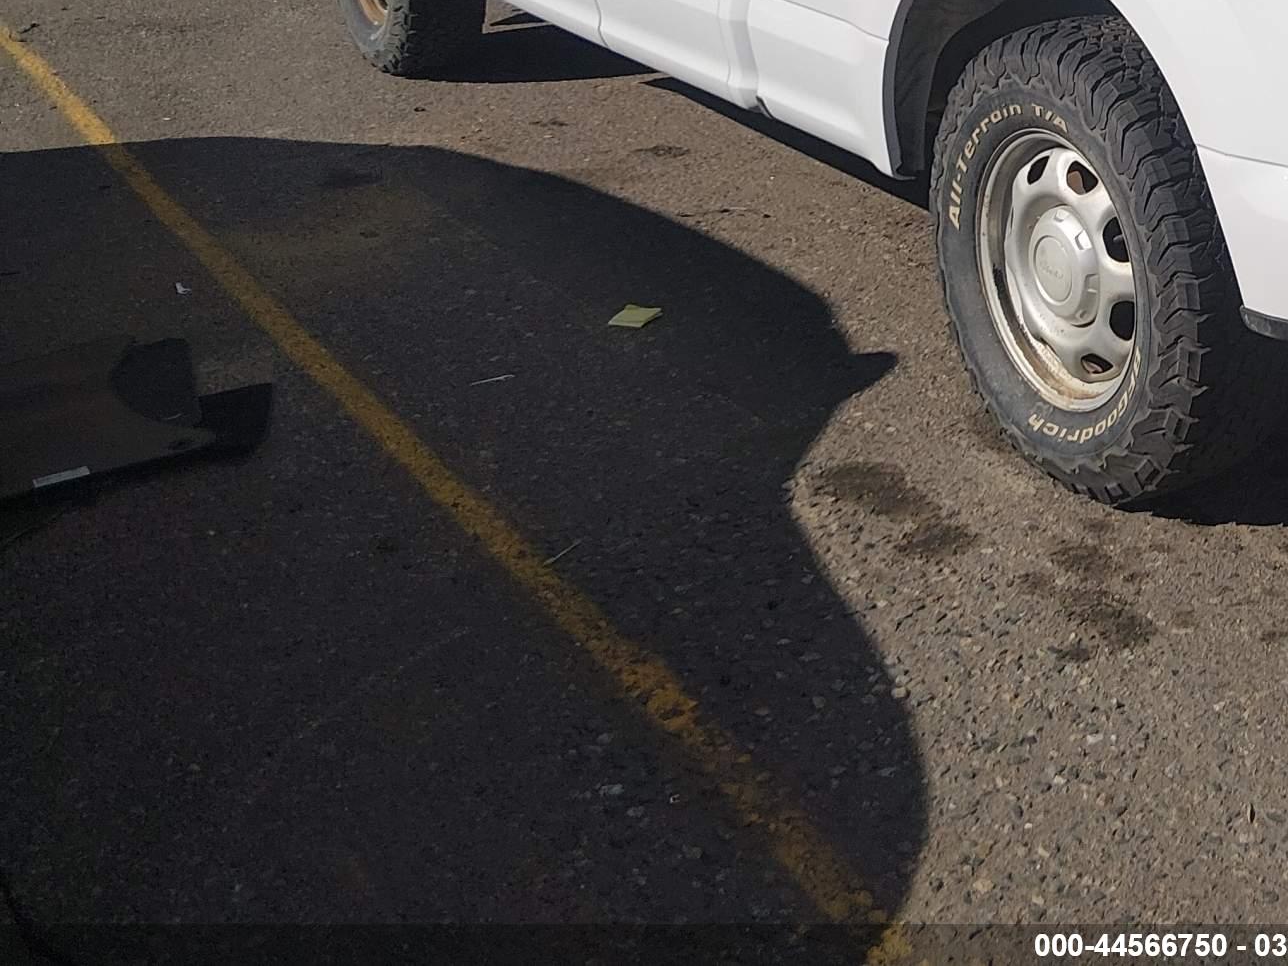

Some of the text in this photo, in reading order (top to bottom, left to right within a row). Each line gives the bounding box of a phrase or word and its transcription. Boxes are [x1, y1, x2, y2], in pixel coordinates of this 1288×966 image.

[948, 103, 1068, 232] All-Terrain T/A
[1027, 346, 1141, 444] BFGoodrich
